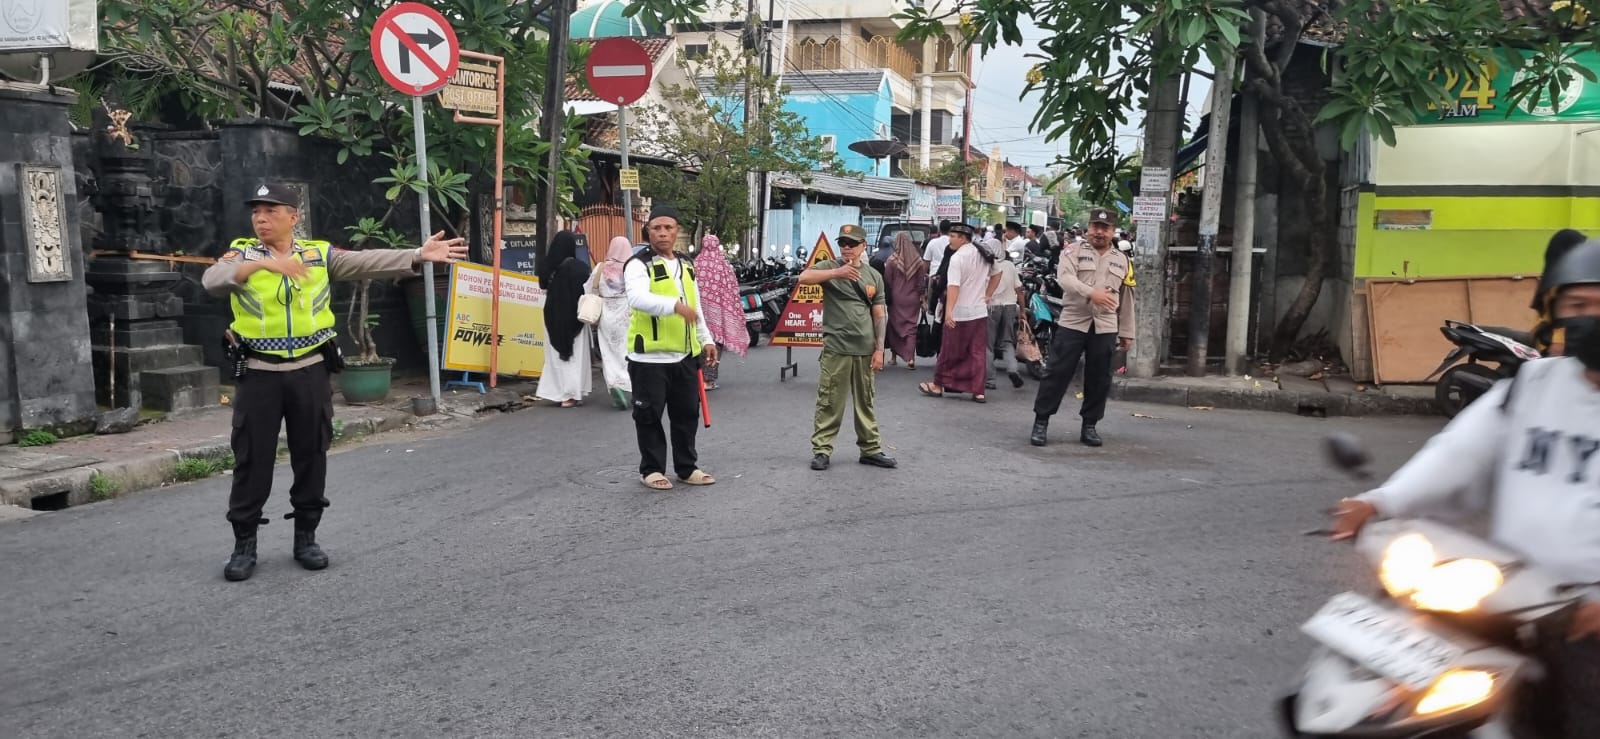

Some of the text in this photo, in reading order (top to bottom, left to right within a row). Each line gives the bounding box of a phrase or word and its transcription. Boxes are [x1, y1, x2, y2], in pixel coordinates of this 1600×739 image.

[457, 273, 482, 284] MOHON
[799, 286, 820, 295] PELAN
[456, 313, 471, 321] ABC
